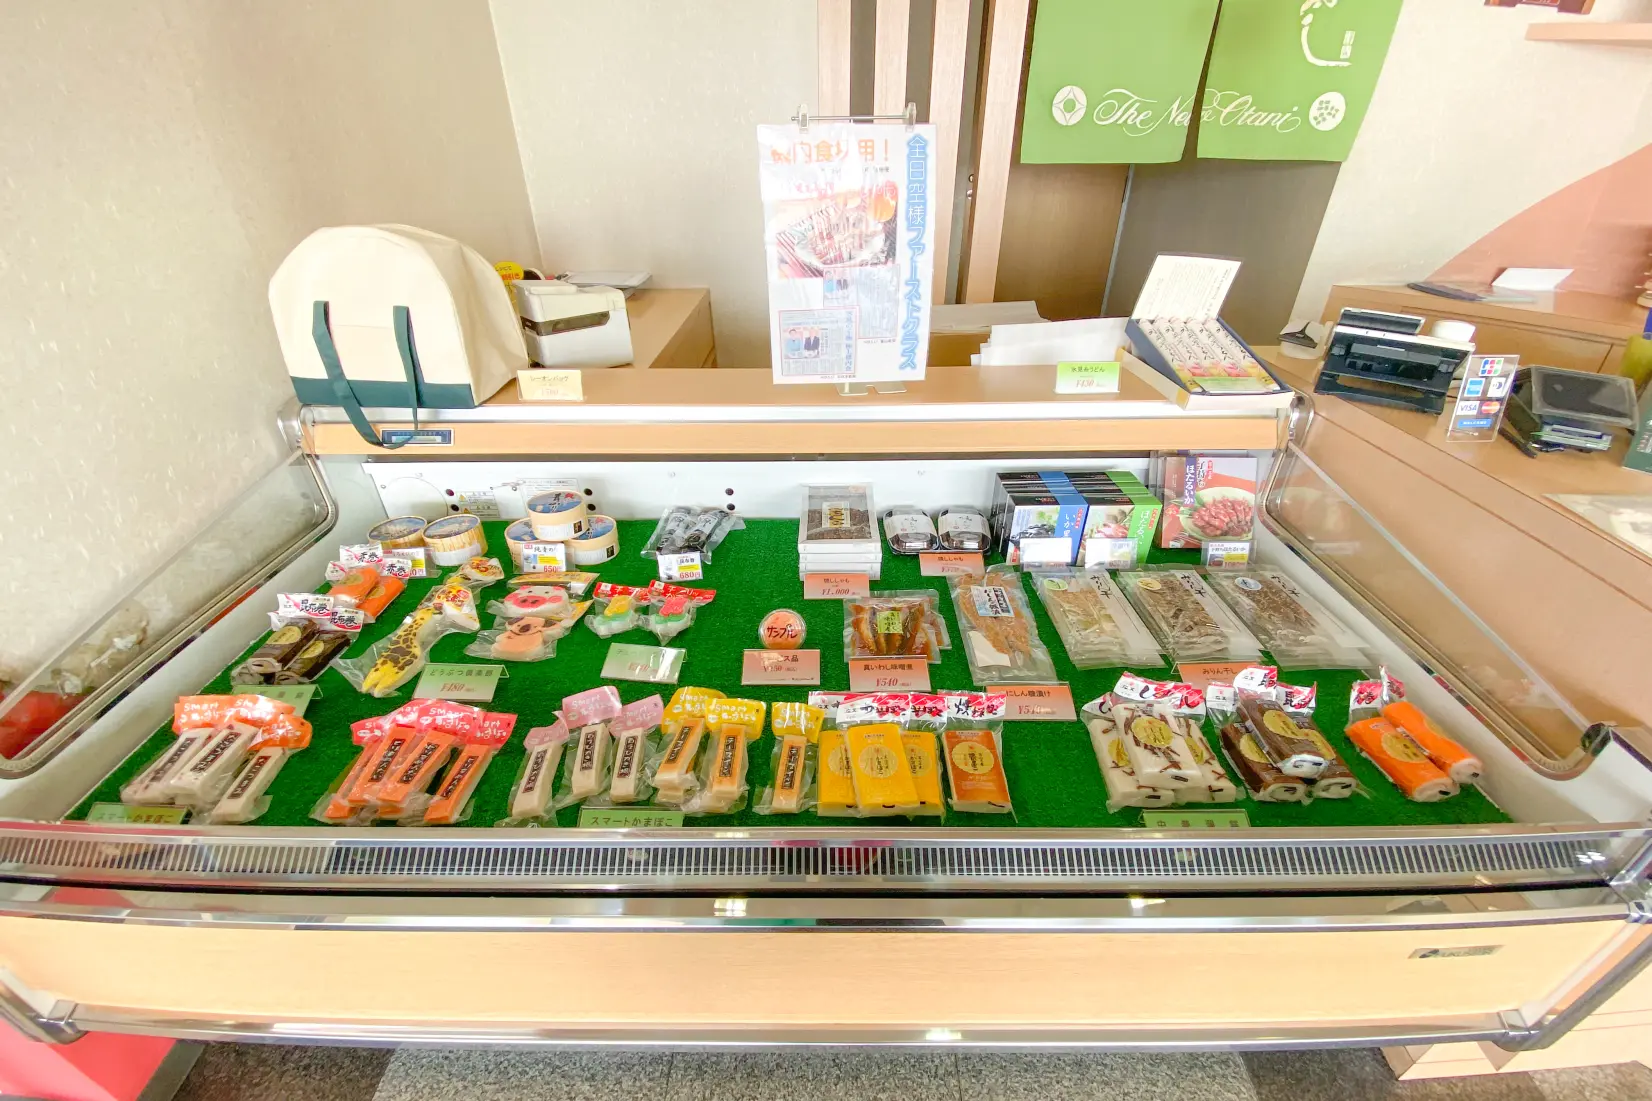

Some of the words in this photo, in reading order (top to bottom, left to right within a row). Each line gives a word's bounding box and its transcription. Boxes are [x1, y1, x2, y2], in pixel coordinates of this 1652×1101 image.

[1208, 89, 1301, 133] Otani
[900, 135, 926, 369] 全日空様ファーストクラス
[1185, 465, 1196, 505] ほたるいか
[359, 551, 379, 562] 赤巻
[386, 564, 406, 577] 赤巻
[300, 599, 330, 614] 昆布巻
[330, 611, 357, 627] 昆布巻
[767, 623, 798, 639] サンプル
[1202, 667, 1237, 675] みりん干し
[591, 816, 673, 827] スマートかまぼこ
